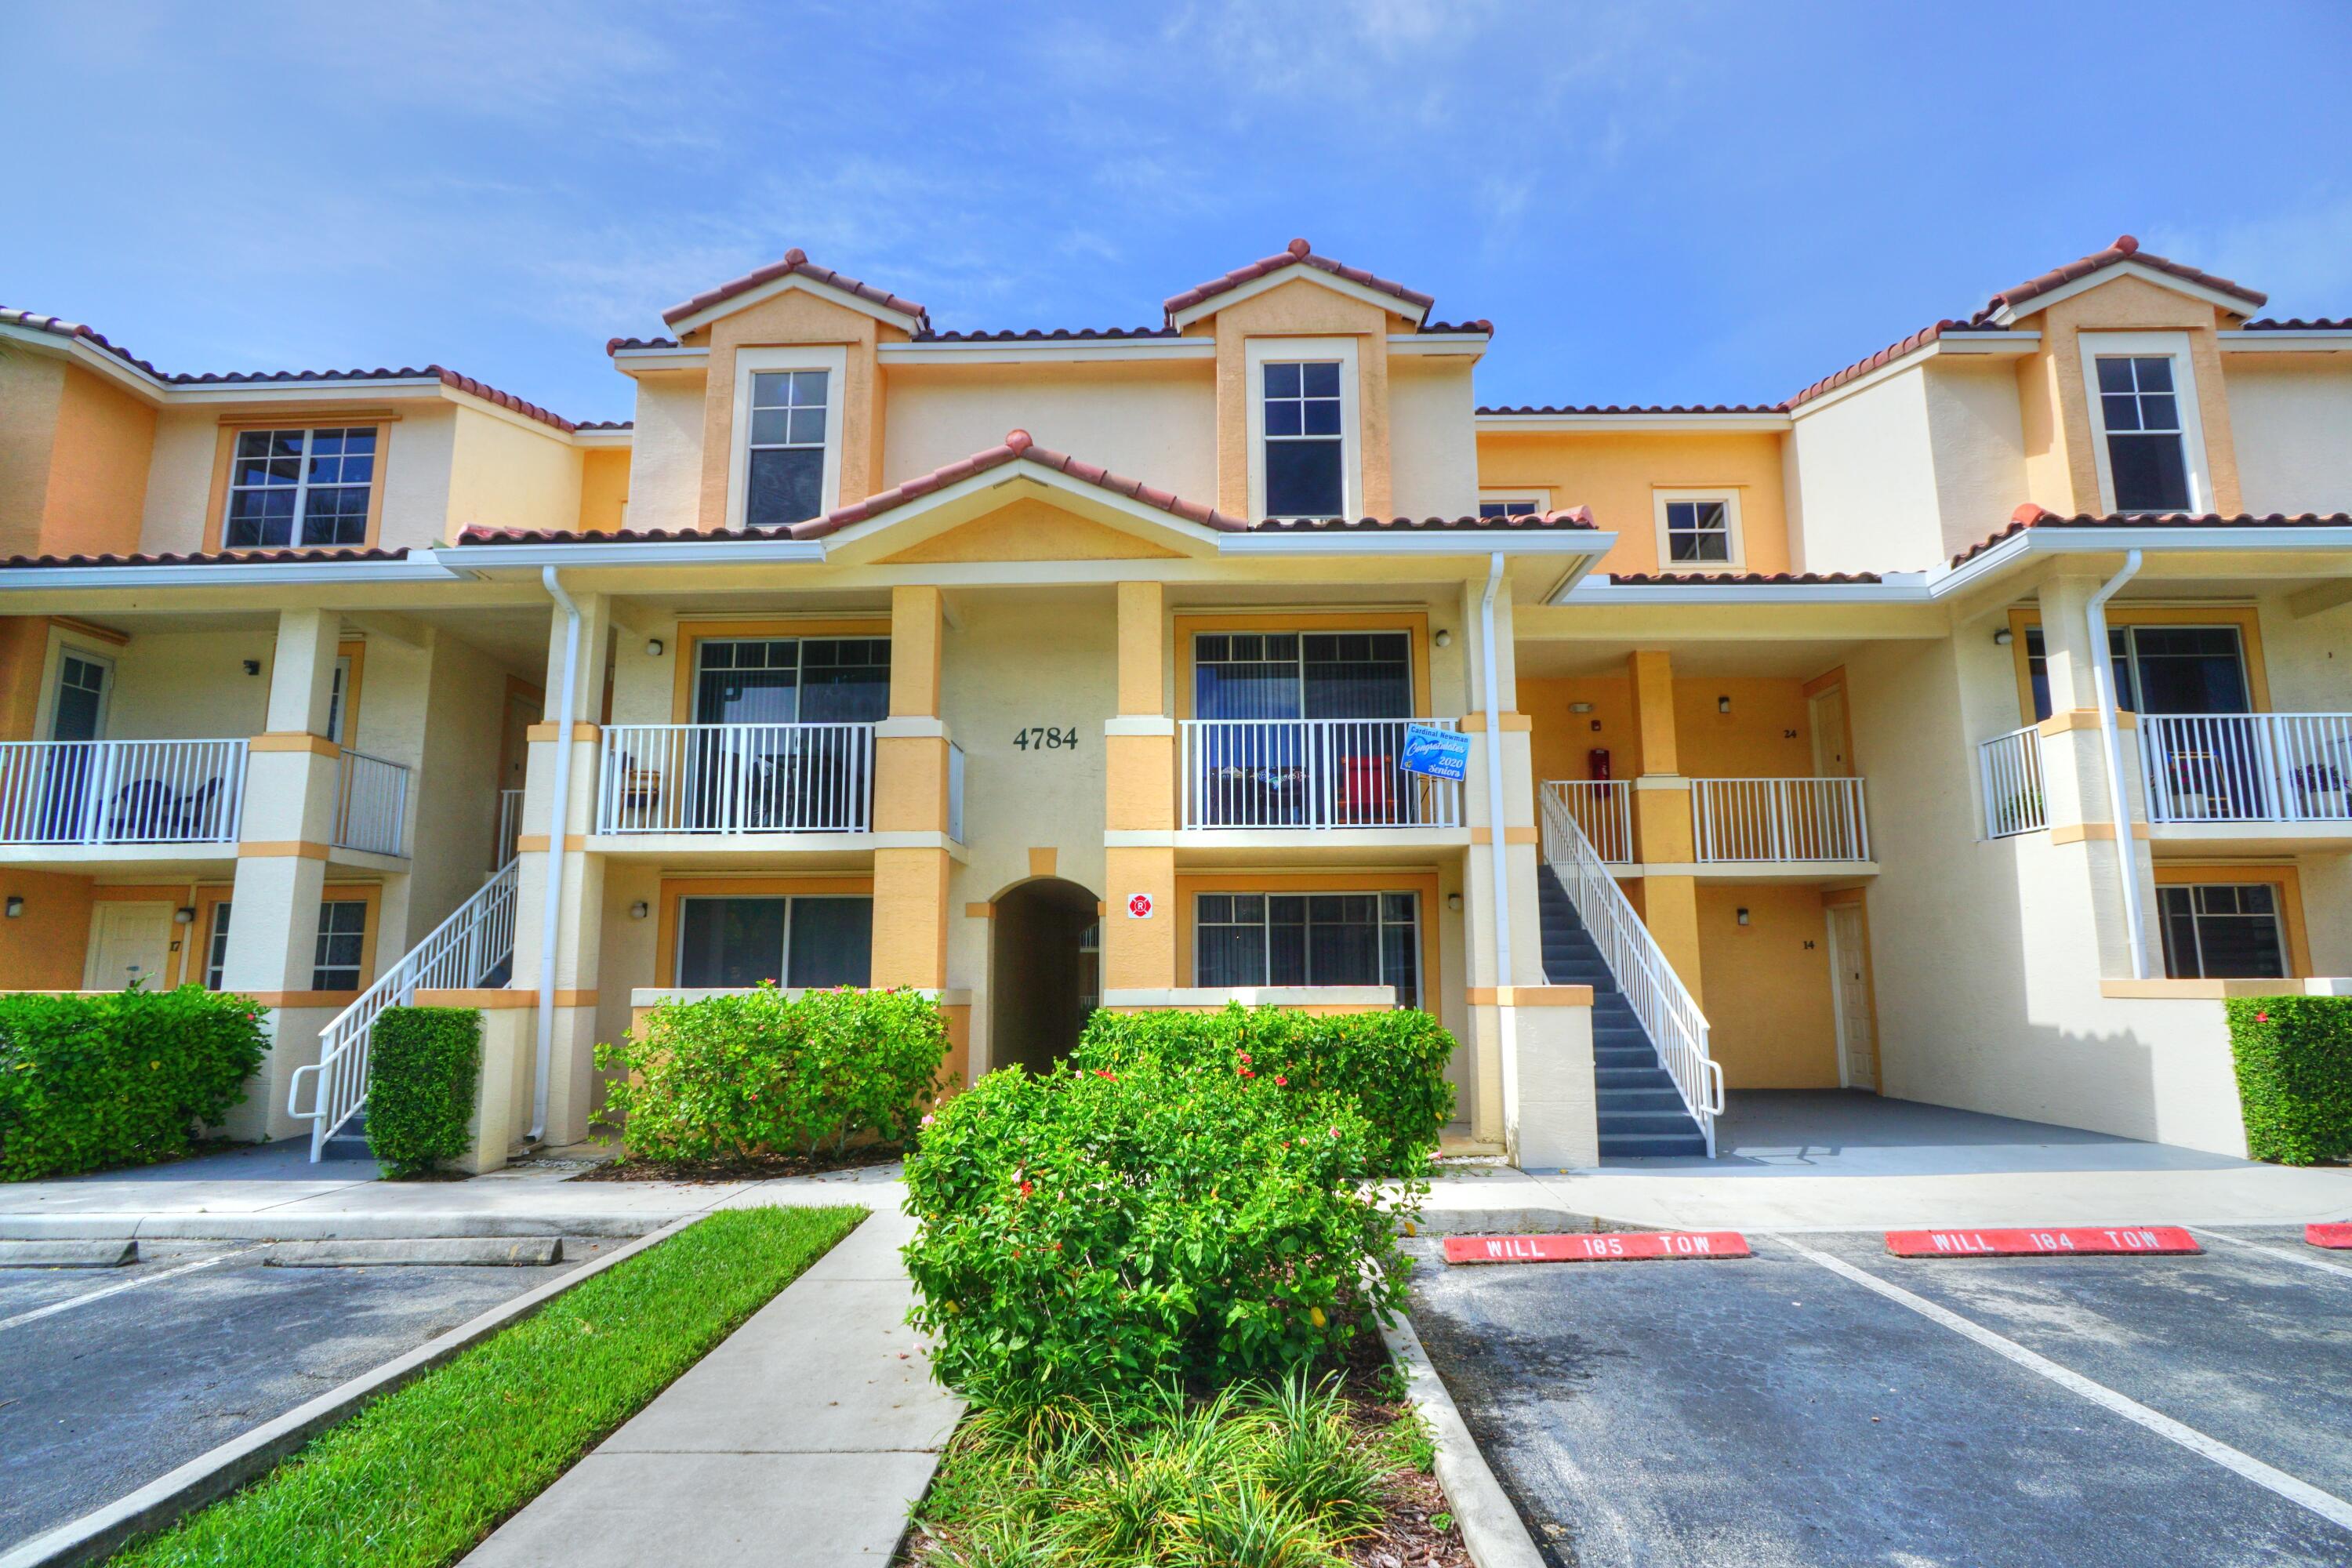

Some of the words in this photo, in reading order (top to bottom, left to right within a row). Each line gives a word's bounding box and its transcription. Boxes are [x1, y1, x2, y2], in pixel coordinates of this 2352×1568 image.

[1013, 727, 1079, 751] 4784
[1411, 726, 1438, 737] Cardinal
[1440, 732, 1468, 743] Newman
[1784, 729, 1797, 739] 24
[1439, 757, 1464, 768] 2020
[1428, 764, 1461, 778] Seniors
[1138, 902, 1144, 910] R
[169, 941, 181, 952] 17
[1803, 940, 1815, 949] 14
[1486, 1240, 1546, 1258] WILL
[1582, 1238, 1624, 1256] 185
[1659, 1236, 1710, 1254] TOW
[1932, 1233, 1995, 1252] WILL
[2030, 1232, 2074, 1250] 184
[2103, 1231, 2161, 1248] TOW
